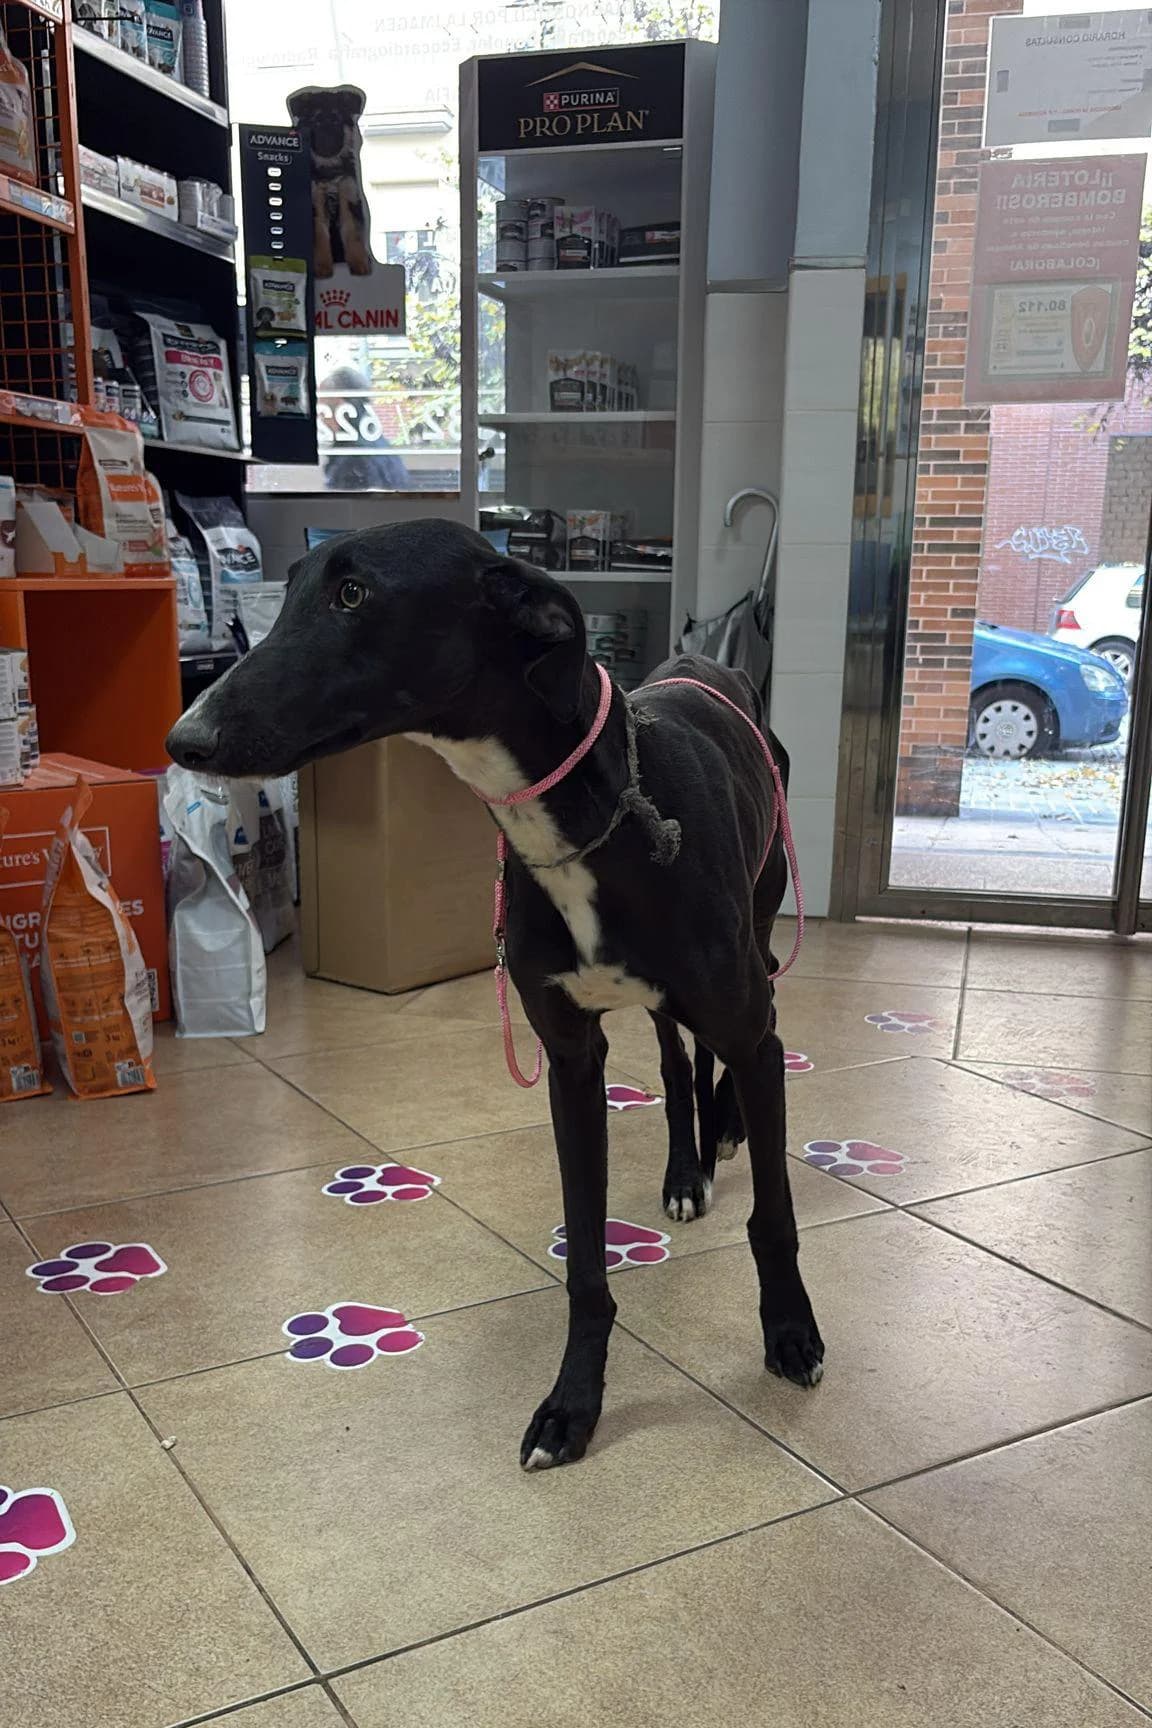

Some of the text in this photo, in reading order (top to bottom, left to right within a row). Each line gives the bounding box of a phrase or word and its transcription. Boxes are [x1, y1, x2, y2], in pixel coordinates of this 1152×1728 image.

[561, 92, 614, 106] PURINA
[518, 110, 646, 138] PRO PLAN
[250, 135, 299, 148] ADVANCE
[257, 151, 289, 163] Snacks
[338, 309, 399, 329] CANIN
[0, 851, 41, 868] ure's
